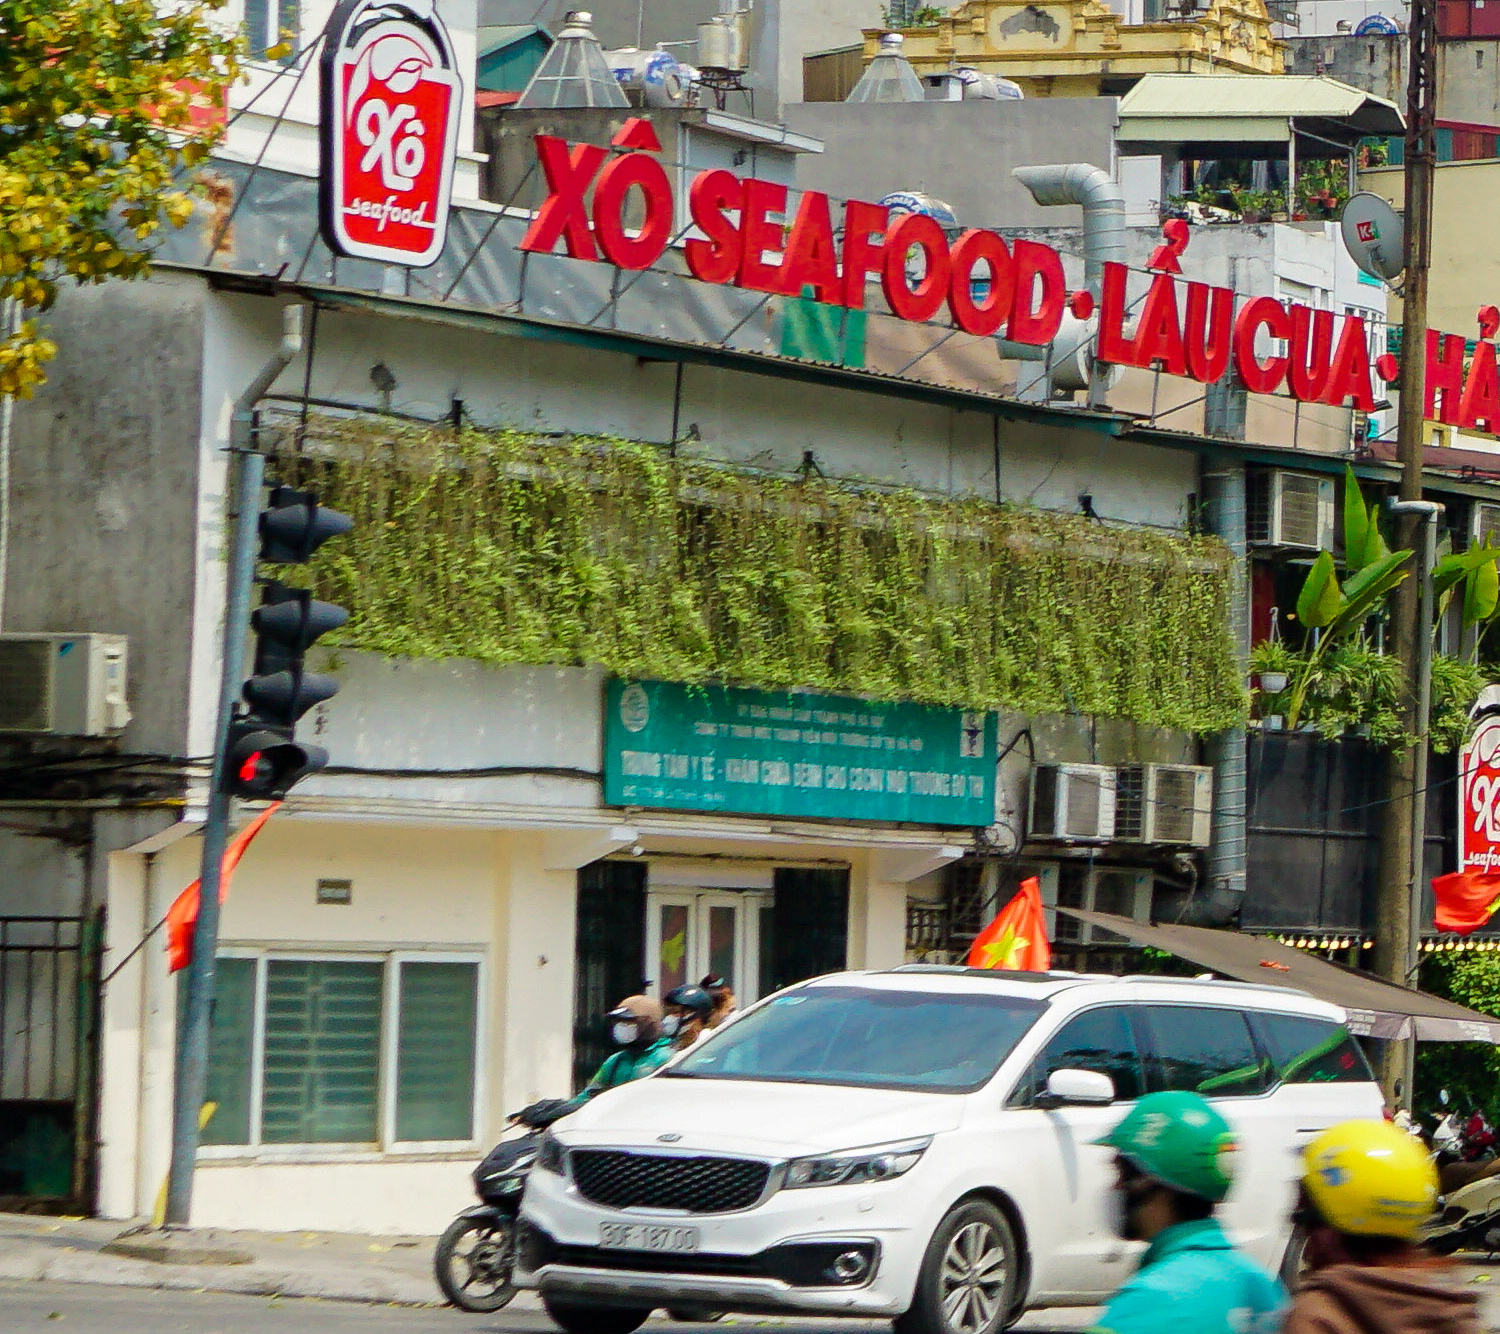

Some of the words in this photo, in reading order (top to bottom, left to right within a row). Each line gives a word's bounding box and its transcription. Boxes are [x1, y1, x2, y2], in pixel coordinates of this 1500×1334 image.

[345, 198, 432, 233] seafood
[520, 118, 674, 271] XÔ
[686, 169, 1066, 346] SEAFOOD
[1097, 218, 1235, 384] LẨU
[1234, 297, 1376, 412] CUA
